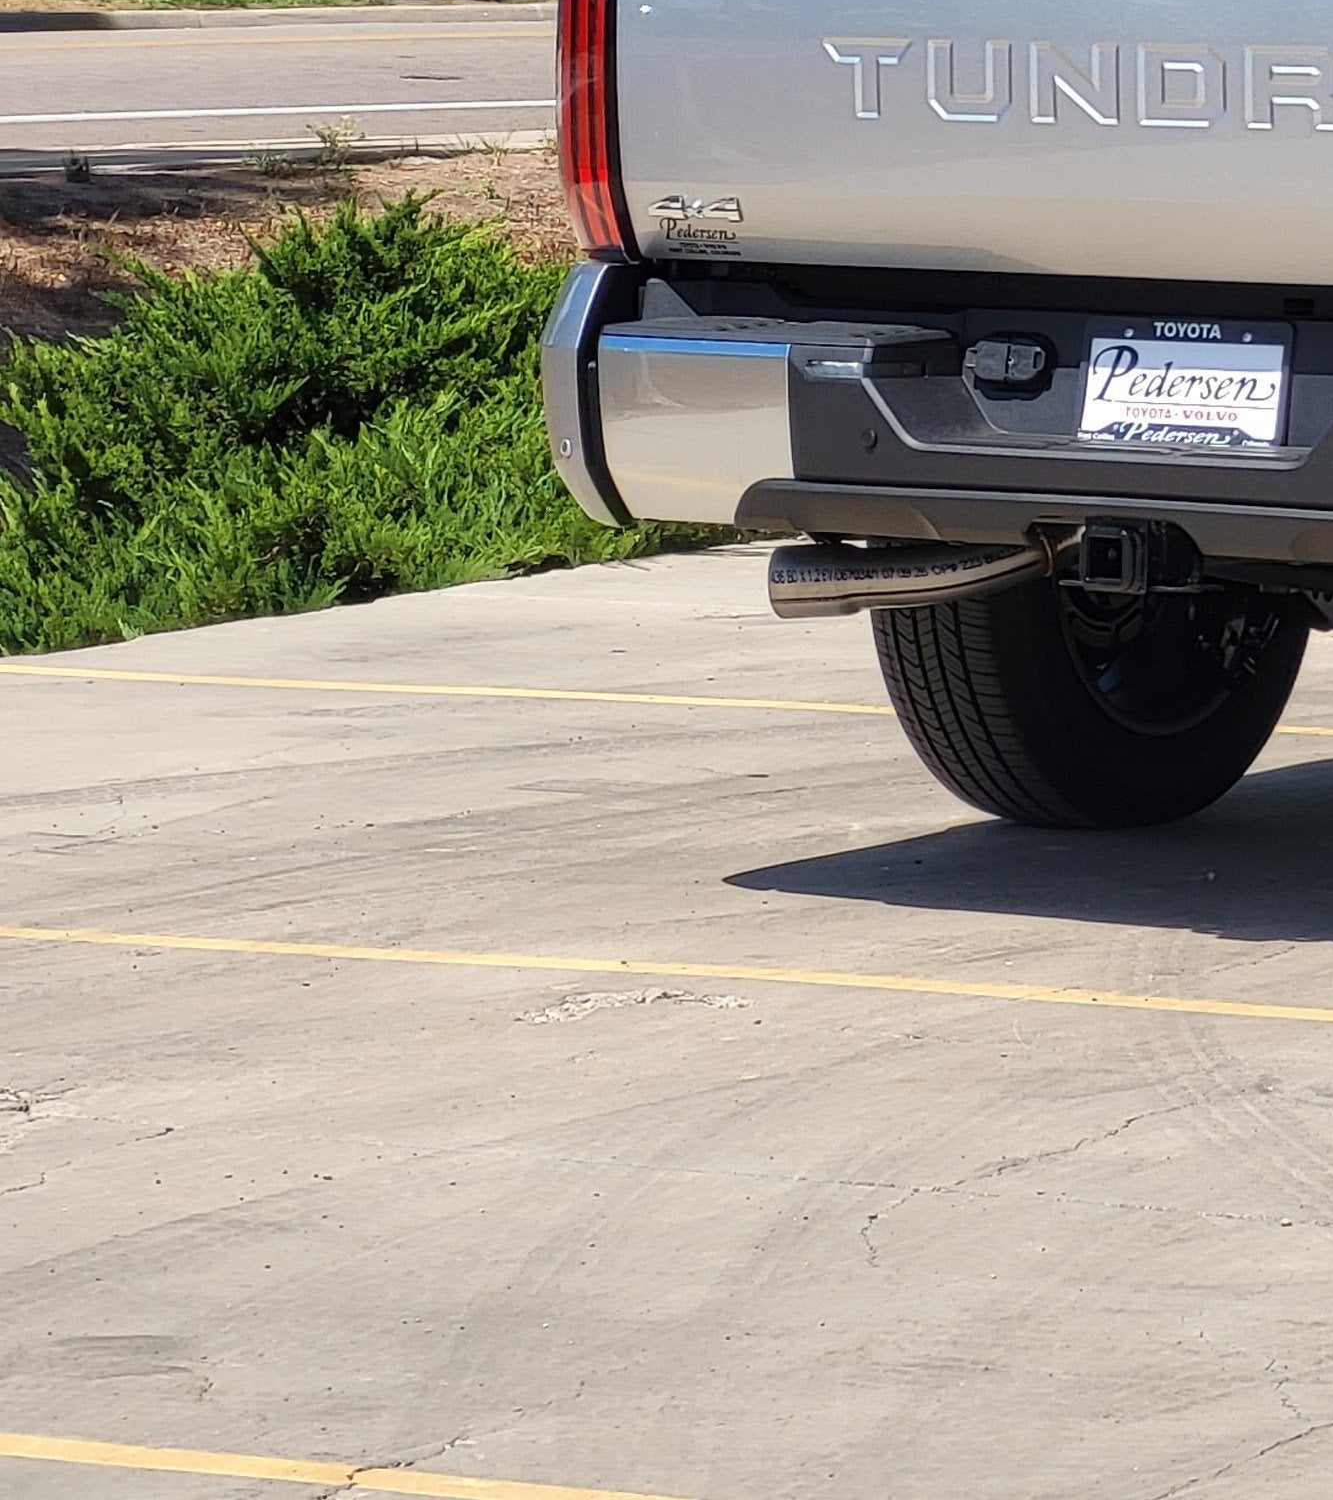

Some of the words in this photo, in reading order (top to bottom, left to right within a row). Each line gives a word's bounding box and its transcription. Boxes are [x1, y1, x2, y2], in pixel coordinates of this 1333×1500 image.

[659, 218, 737, 241] Pedersen
[1154, 321, 1222, 340] TOYOTA
[1093, 345, 1276, 402] Pedersen
[1126, 406, 1172, 419] TOYOTA
[1183, 410, 1238, 421] VOLVO
[1119, 421, 1231, 446] Pedersen
